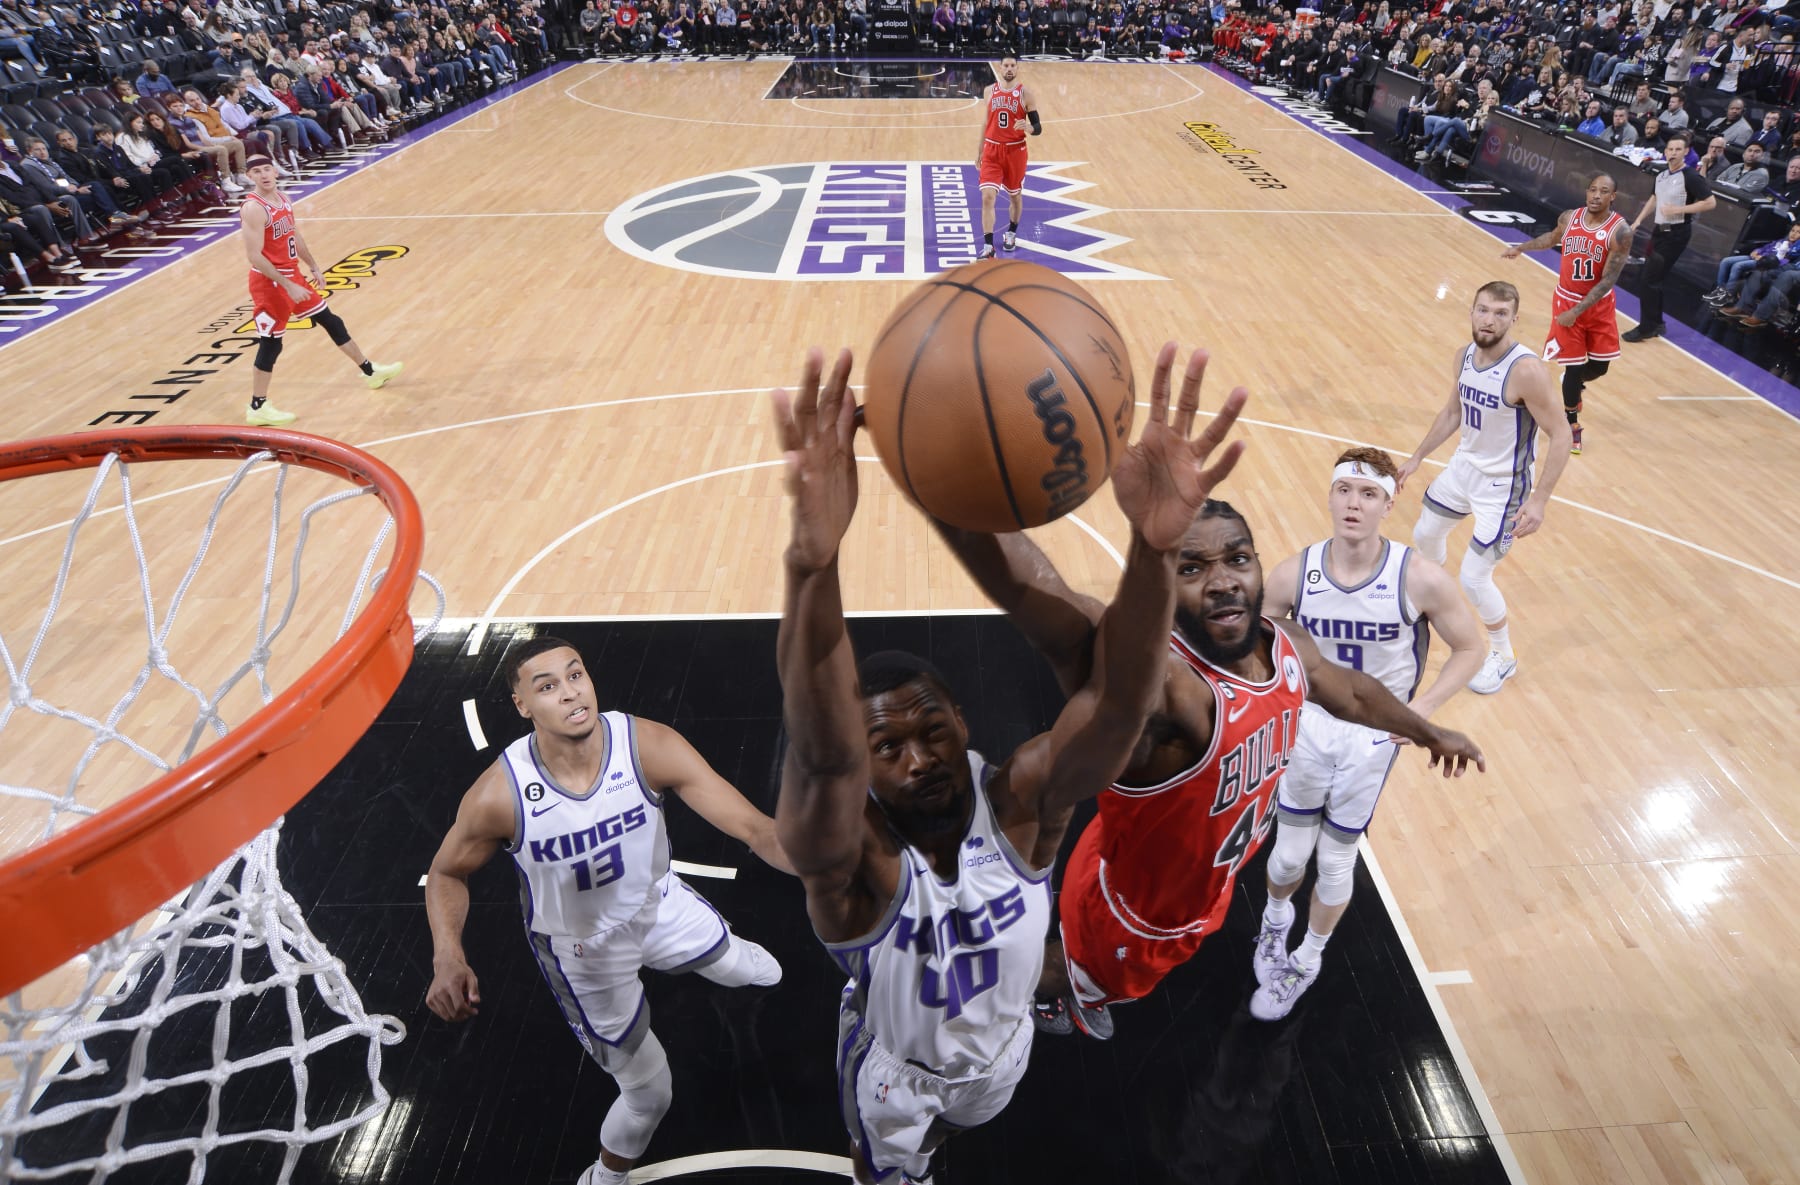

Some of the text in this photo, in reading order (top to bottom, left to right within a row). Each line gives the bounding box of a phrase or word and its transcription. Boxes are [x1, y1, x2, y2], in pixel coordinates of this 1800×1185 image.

[991, 95, 1018, 114] BULLS
[998, 110, 1009, 128] 9
[1270, 96, 1375, 135] dialpad
[1221, 154, 1288, 190] CENTER
[1506, 142, 1556, 179] TOYOTA
[796, 164, 908, 274] KINGS
[931, 165, 978, 268] SACRAMENTO
[1564, 236, 1604, 263] BULLS
[1572, 257, 1594, 281] 11
[86, 336, 263, 427] CENTE
[1463, 402, 1482, 431] 10
[1308, 570, 1321, 584] 6
[1367, 592, 1395, 601] dialpad
[1301, 614, 1400, 642] KINGS
[1336, 642, 1363, 672] 9
[1209, 706, 1303, 817] BULL
[528, 783, 543, 800] 6
[605, 778, 635, 795] dialpad
[529, 802, 647, 863] KINGS
[570, 842, 625, 892] 13
[918, 947, 999, 1022] 40
